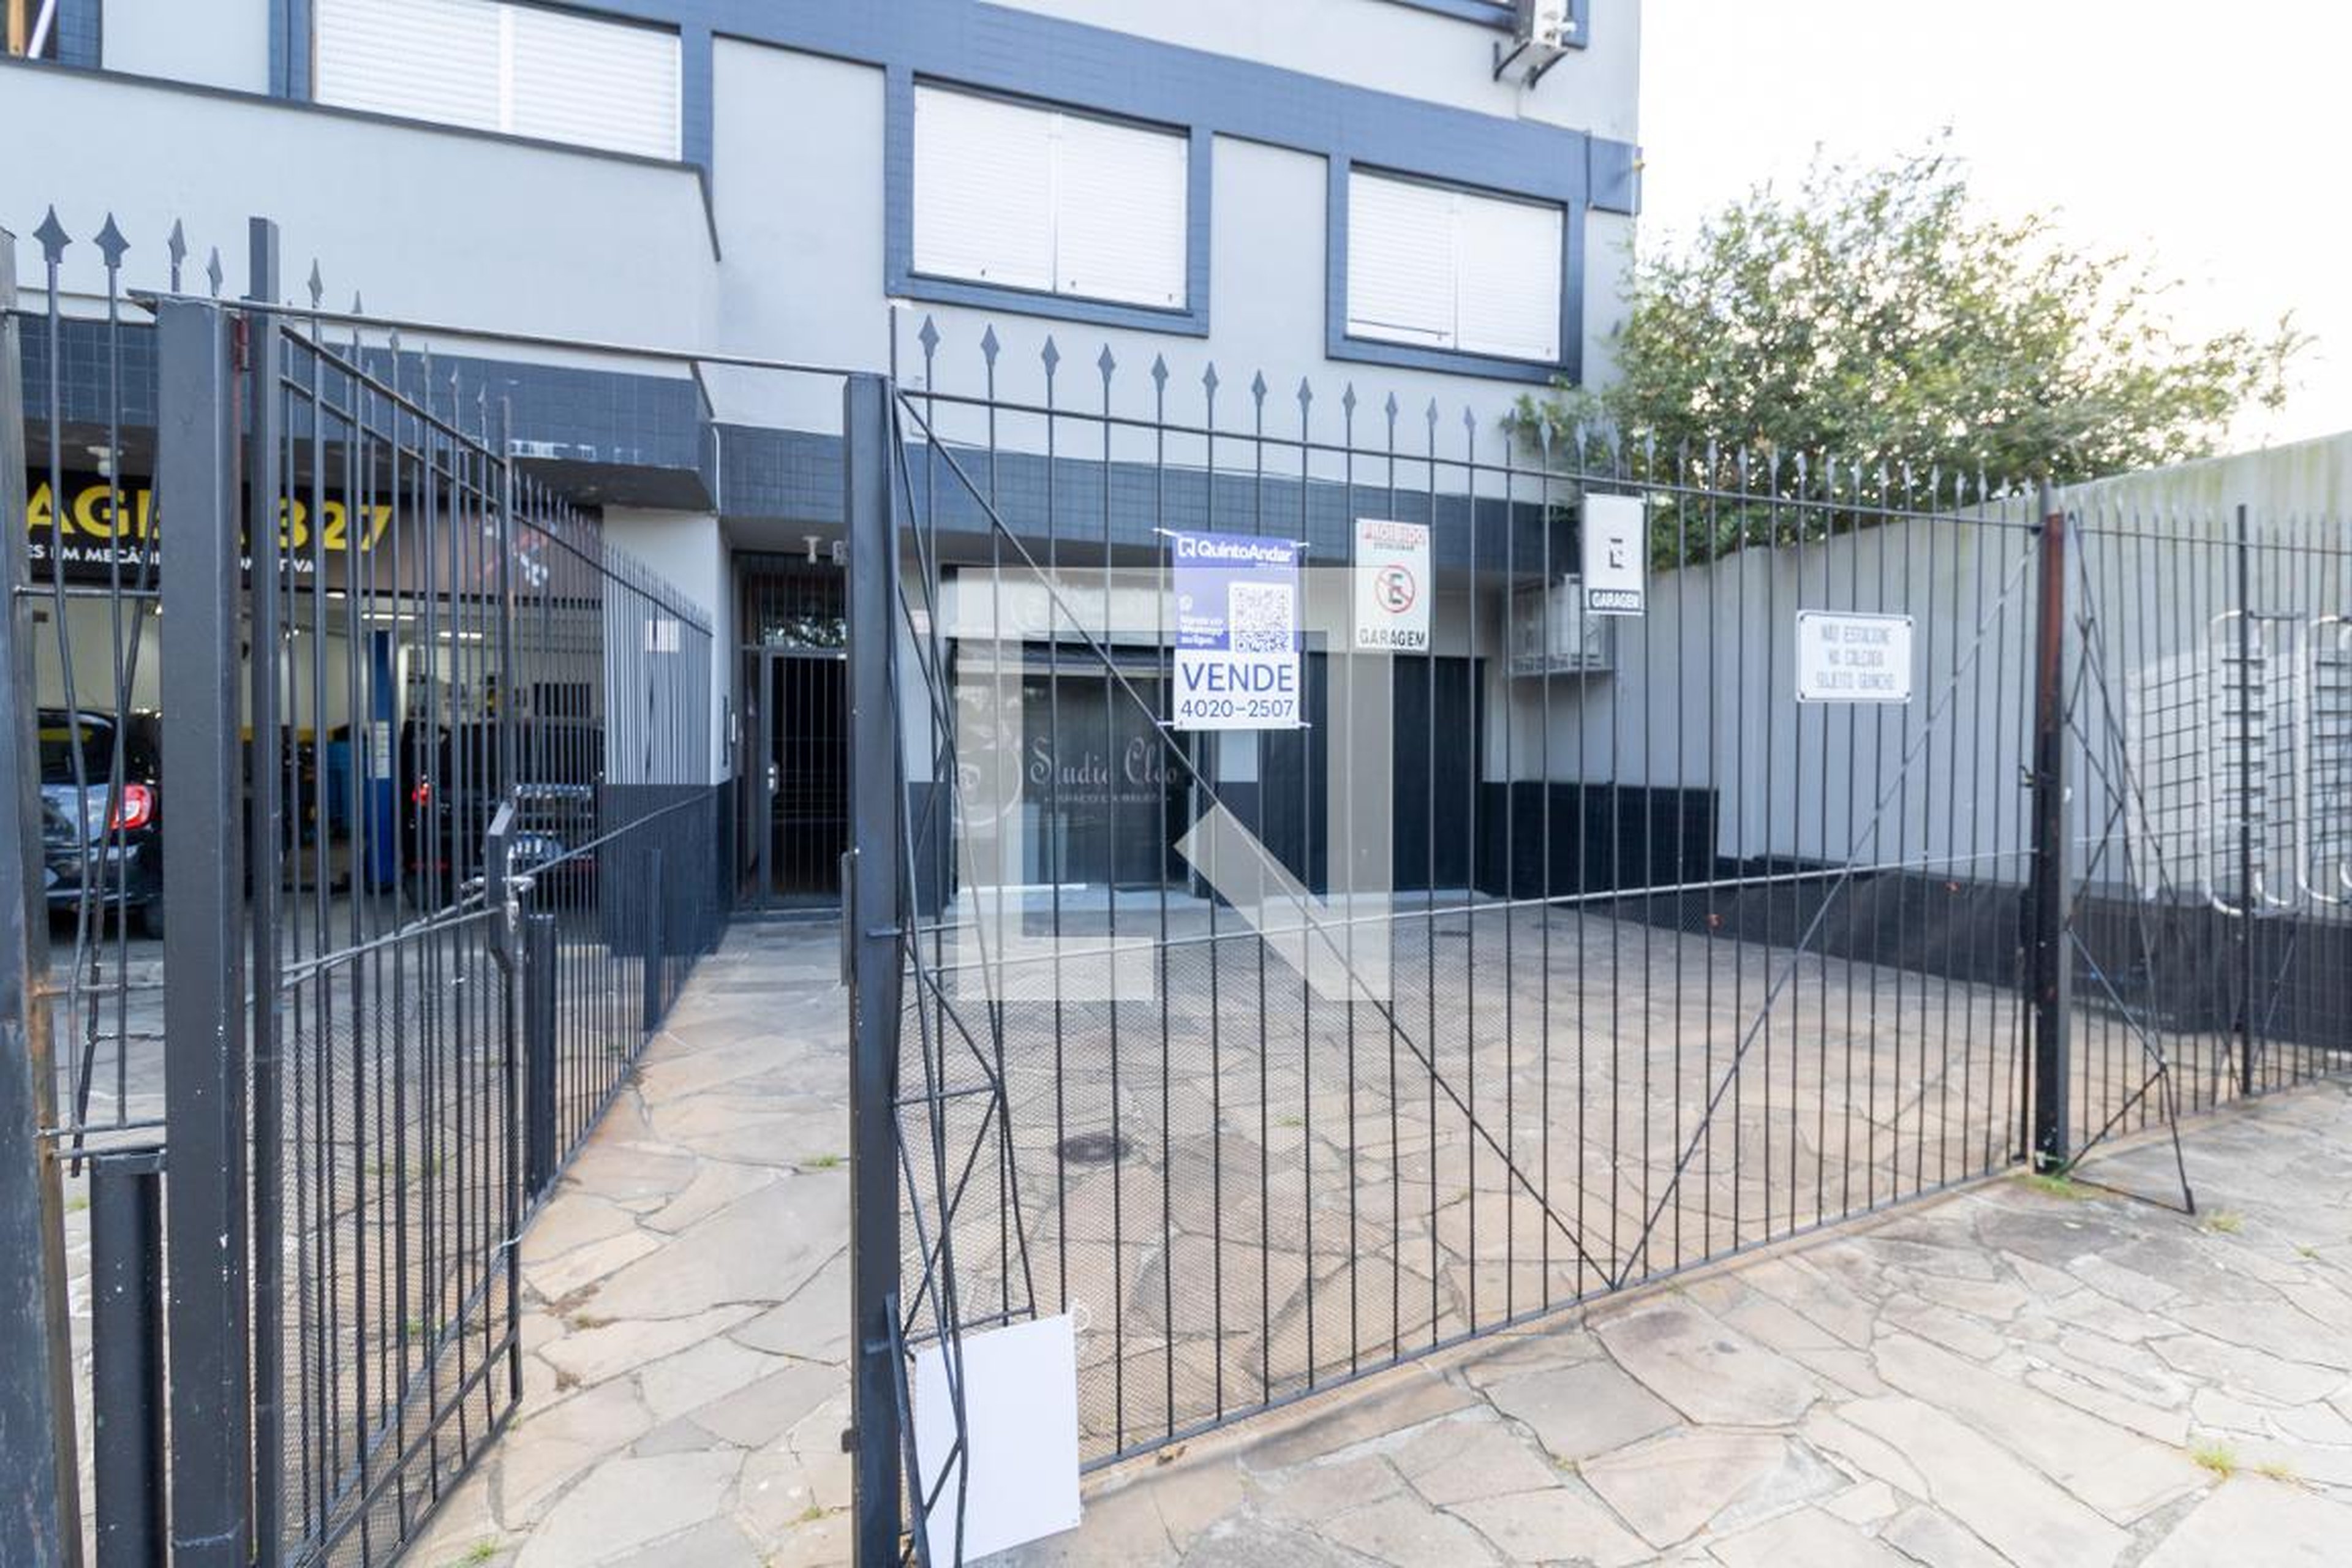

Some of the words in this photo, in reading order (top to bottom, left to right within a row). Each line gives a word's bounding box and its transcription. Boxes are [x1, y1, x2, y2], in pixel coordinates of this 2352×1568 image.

[1197, 540, 1292, 562] QuintoAndar
[1592, 591, 1640, 609] GARAGEM
[1359, 628, 1425, 646] GARAGEM
[1182, 662, 1294, 692] VENDE
[1181, 699, 1294, 717] 4020-2507
